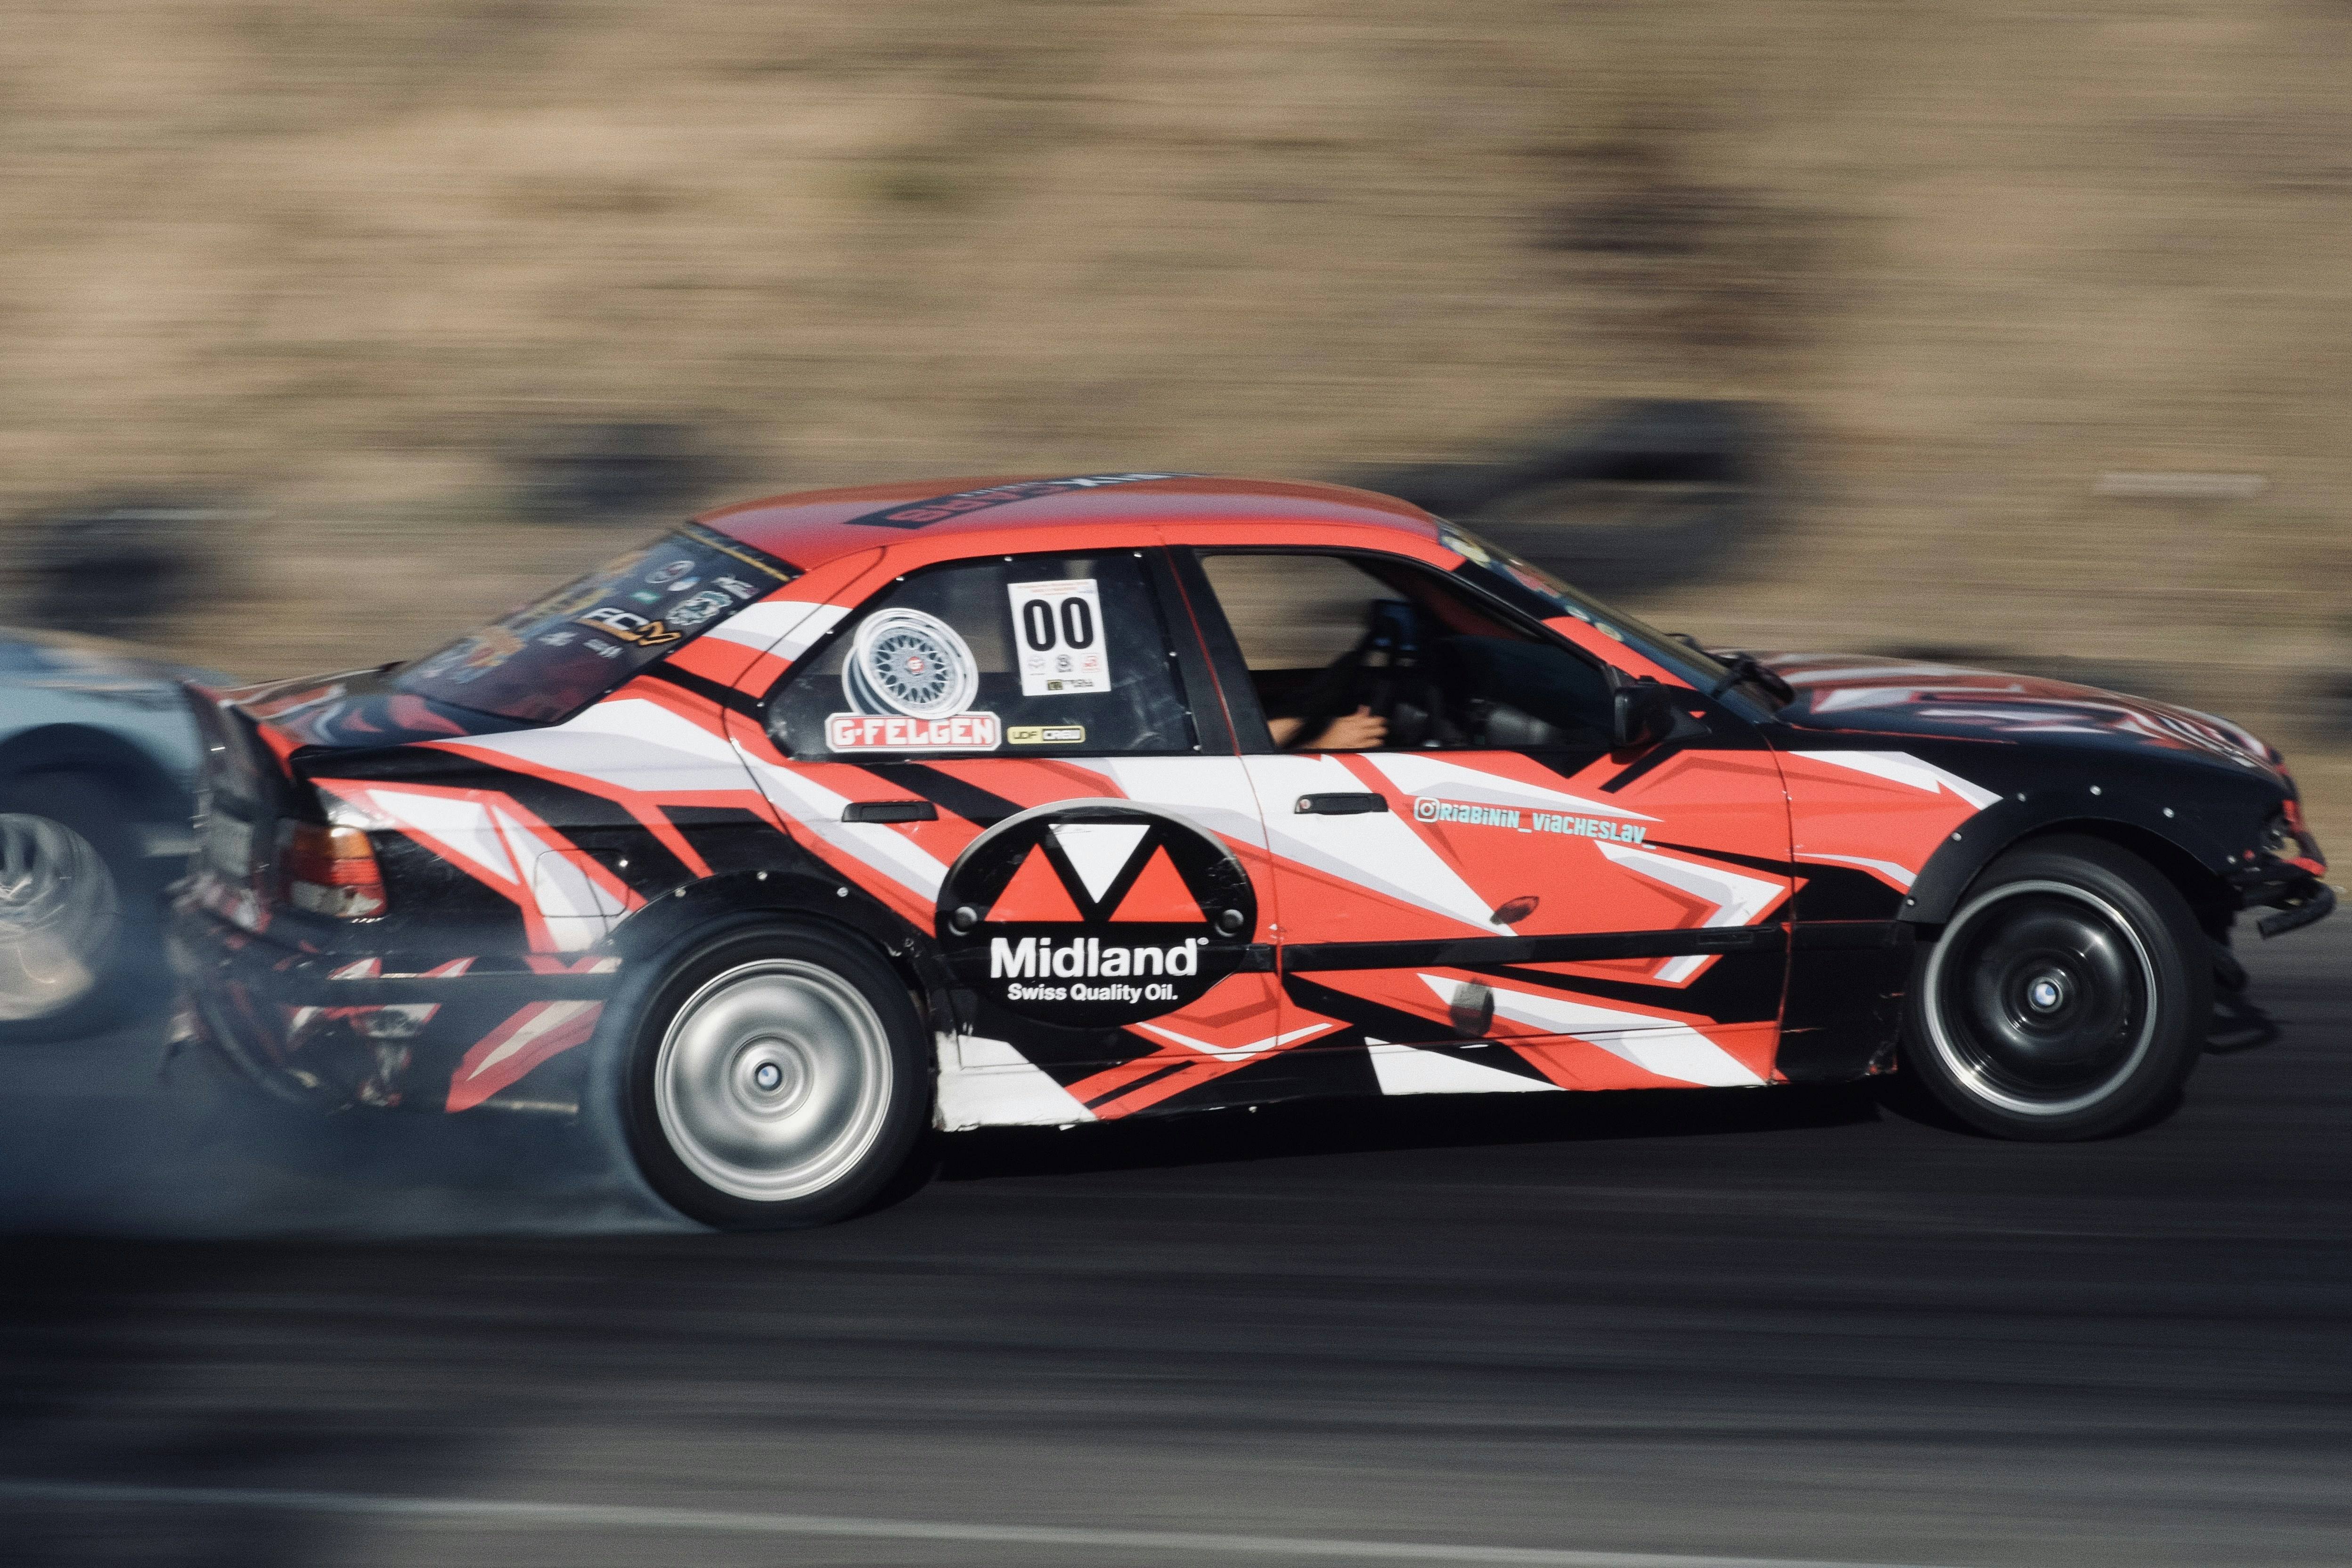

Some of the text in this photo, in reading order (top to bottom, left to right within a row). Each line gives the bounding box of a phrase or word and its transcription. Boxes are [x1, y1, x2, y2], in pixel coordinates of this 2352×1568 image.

[1023, 596, 1094, 652] 00
[833, 718, 995, 746] G-FELGEN
[990, 937, 1198, 978] Midland
[1007, 983, 1178, 1004] Swiss Quality Oil.
